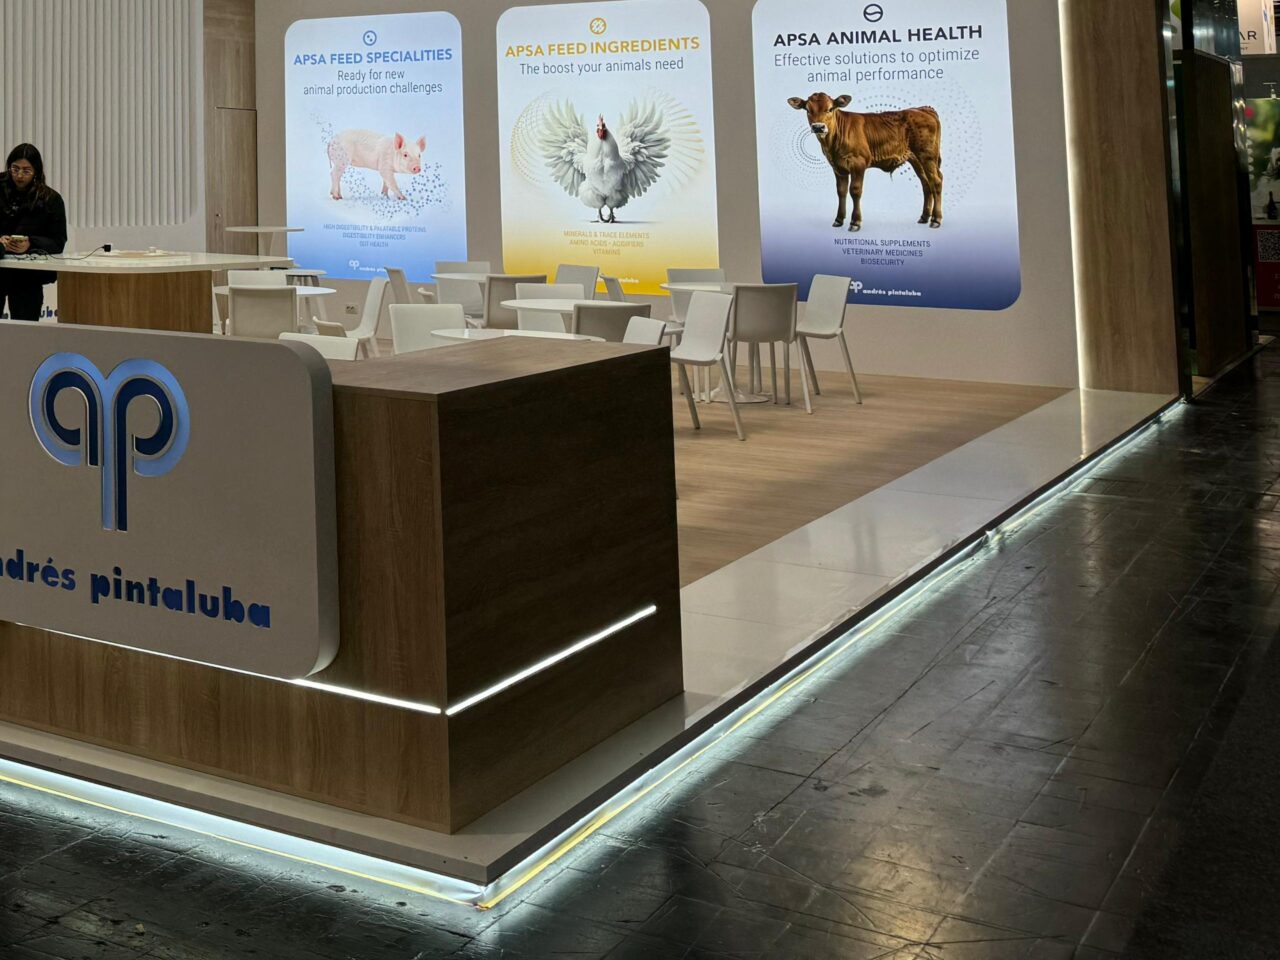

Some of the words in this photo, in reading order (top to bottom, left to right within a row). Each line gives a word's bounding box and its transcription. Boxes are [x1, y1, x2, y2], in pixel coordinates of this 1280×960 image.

[773, 32, 822, 47] APSA
[826, 29, 902, 45] ANIMAL
[907, 25, 982, 41] HEALTH
[505, 44, 545, 57] APSA
[548, 42, 587, 55] FEED
[590, 36, 700, 54] INGREDIENTS
[293, 53, 326, 66] APSA
[330, 53, 363, 65] FEED
[366, 48, 453, 64] SPECIALITIES
[774, 52, 831, 67] Effective
[835, 50, 896, 65] solutions
[901, 49, 914, 63] to
[919, 48, 980, 65] optimize
[337, 69, 366, 83] Ready
[369, 68, 382, 80] for
[385, 70, 405, 80] new
[520, 63, 540, 75] The
[543, 61, 573, 74] boost
[578, 63, 601, 77] your
[605, 58, 651, 72] animals
[655, 57, 684, 70] need
[807, 69, 851, 83] animal
[856, 67, 944, 85] performance
[303, 84, 334, 95] animal
[336, 83, 387, 97] production
[389, 82, 443, 96] challenges
[834, 238, 878, 246] NUTRITIONAL
[880, 239, 931, 247] SUPPLEMENTS
[842, 247, 883, 256] VETERINARY
[885, 248, 923, 257] MEDICINES
[860, 257, 905, 266] BIOSECURITY
[90, 566, 271, 628] pintaluba
